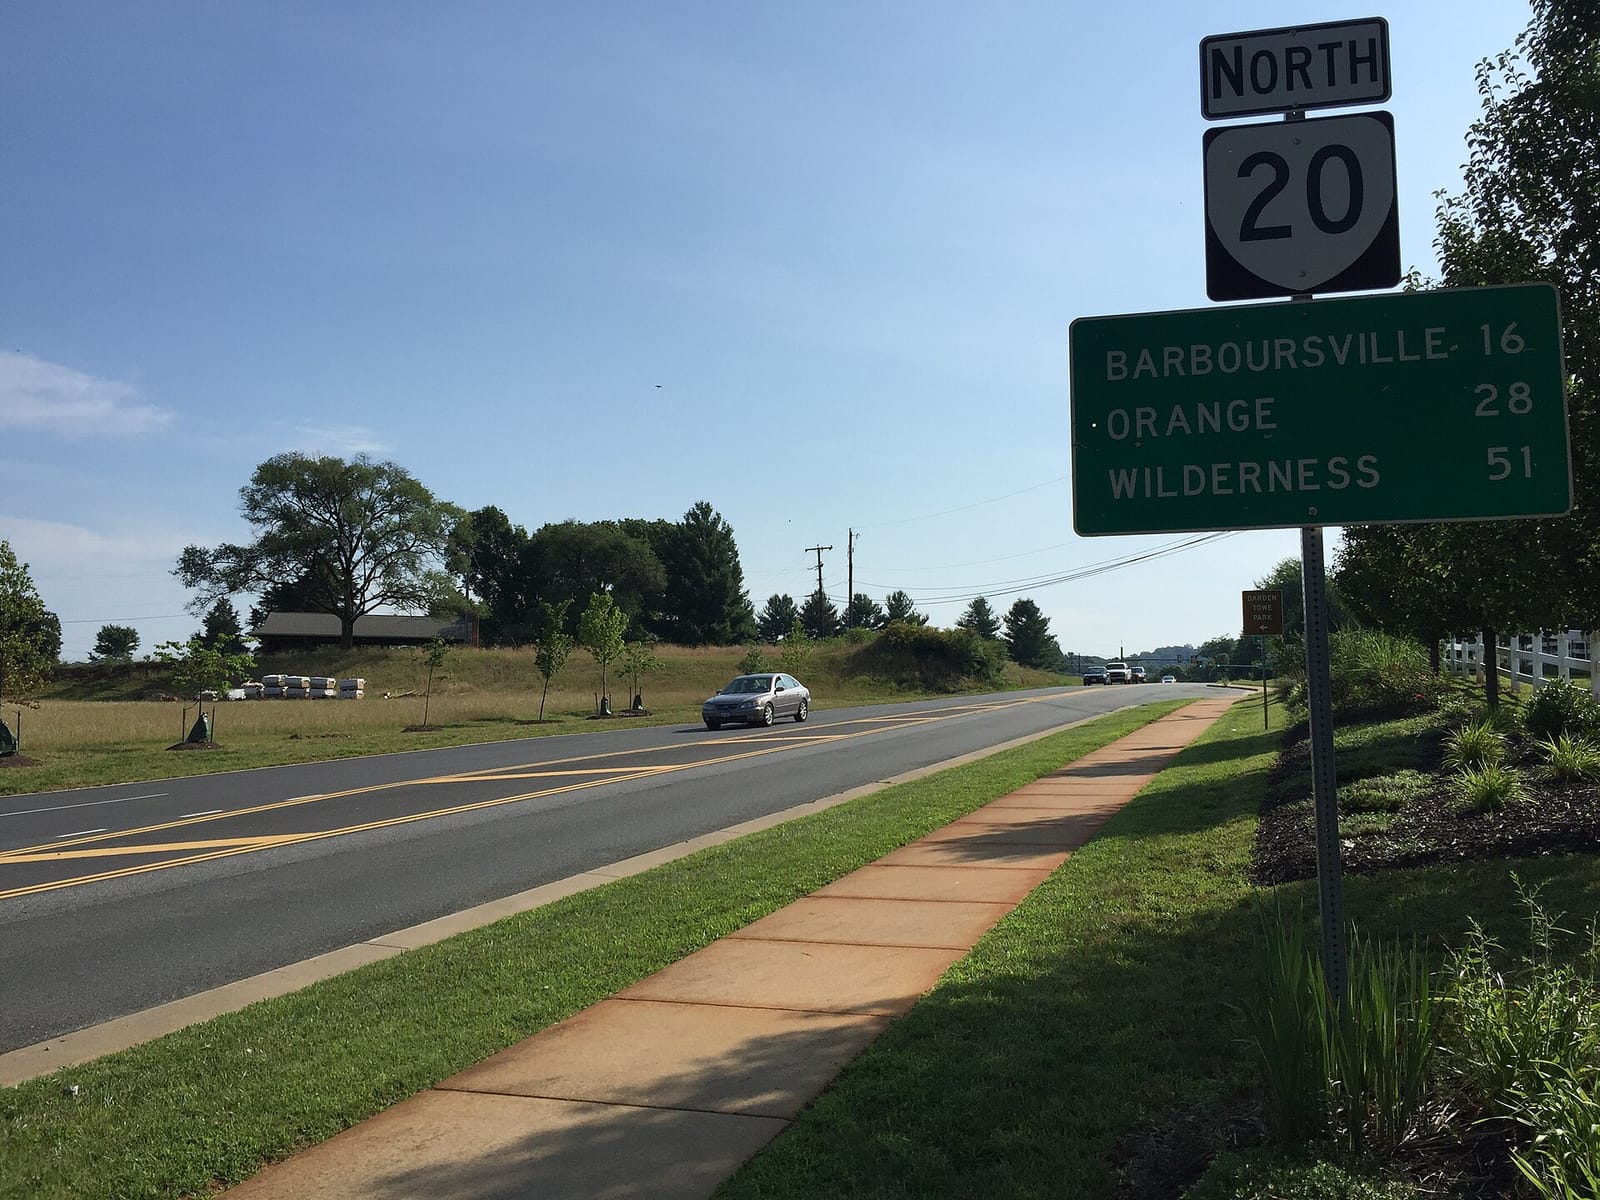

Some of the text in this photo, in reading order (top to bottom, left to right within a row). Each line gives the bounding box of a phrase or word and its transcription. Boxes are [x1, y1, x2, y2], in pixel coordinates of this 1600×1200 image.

[1211, 37, 1379, 100] NORTH
[1237, 144, 1364, 242] 20
[1106, 322, 1526, 382] BARBOURSVILLE 16
[1107, 381, 1534, 441] ORANGE 28
[1108, 445, 1532, 500] WILDERNESS 51
